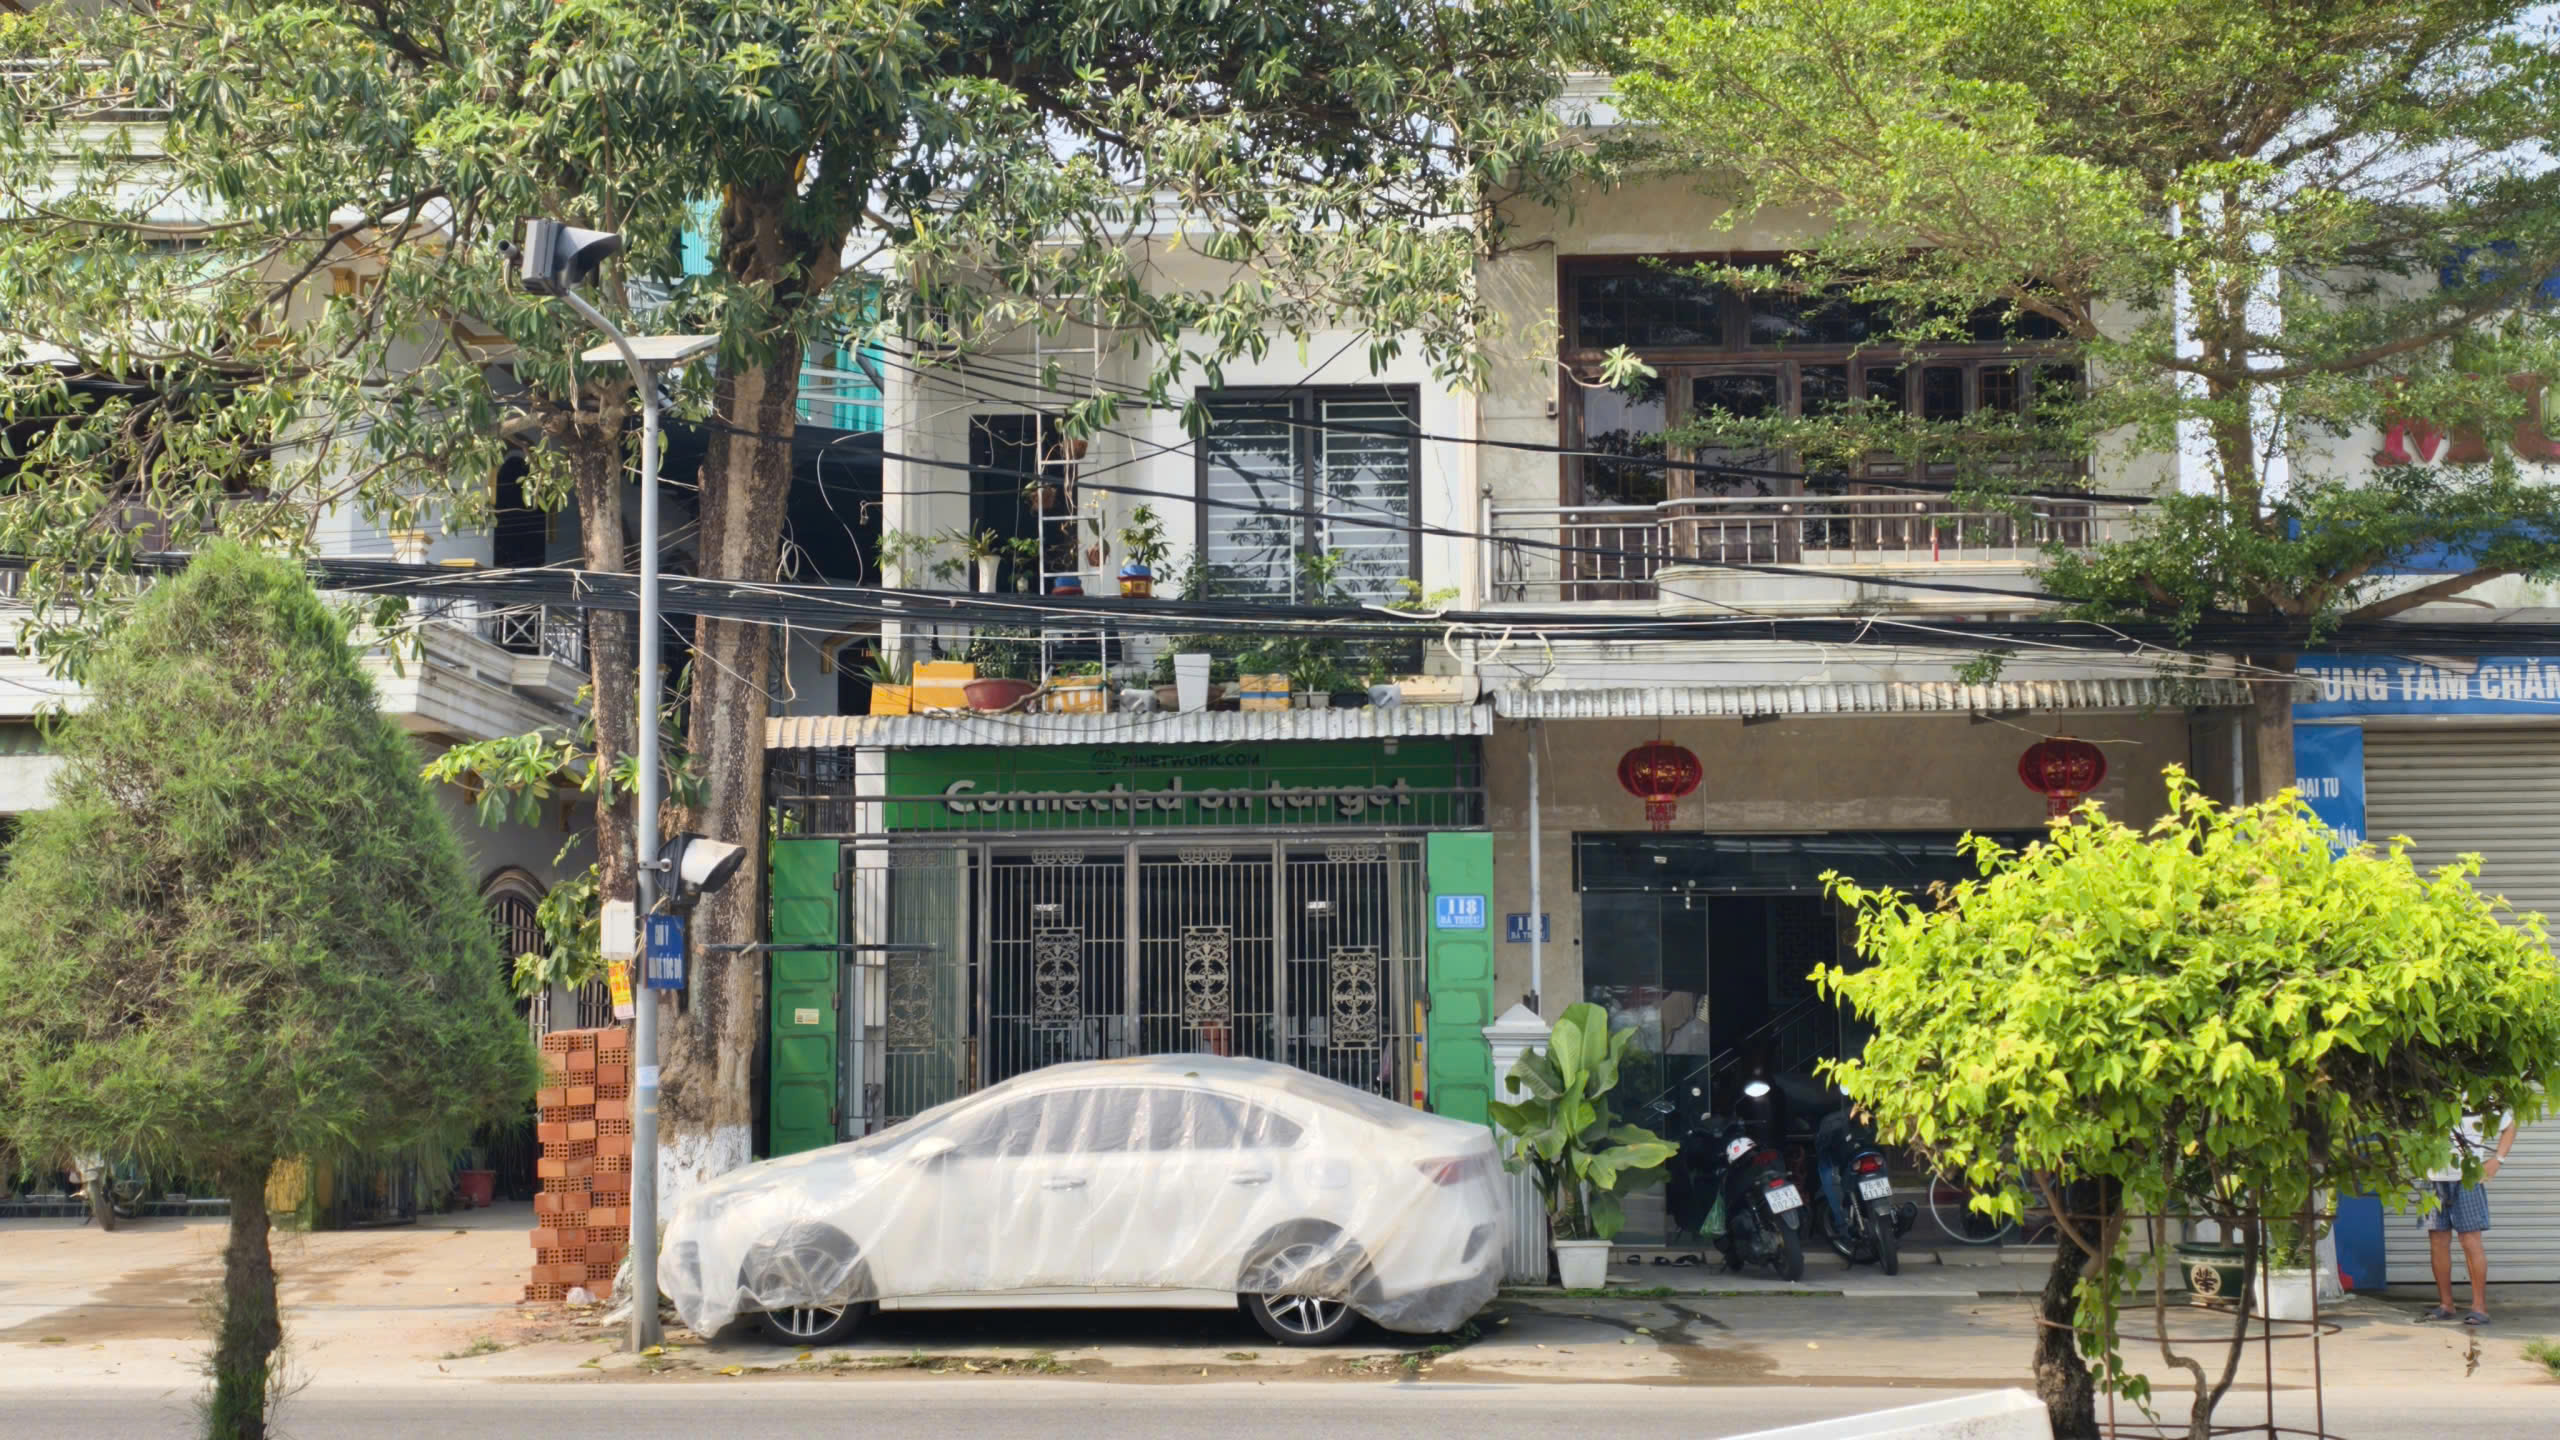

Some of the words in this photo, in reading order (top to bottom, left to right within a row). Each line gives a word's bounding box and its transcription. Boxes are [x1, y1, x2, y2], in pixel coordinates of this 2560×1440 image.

[945, 776, 1182, 813] Connected
[1200, 787, 1252, 809] on
[1271, 777, 1411, 816] target
[1448, 898, 1478, 915] 118
